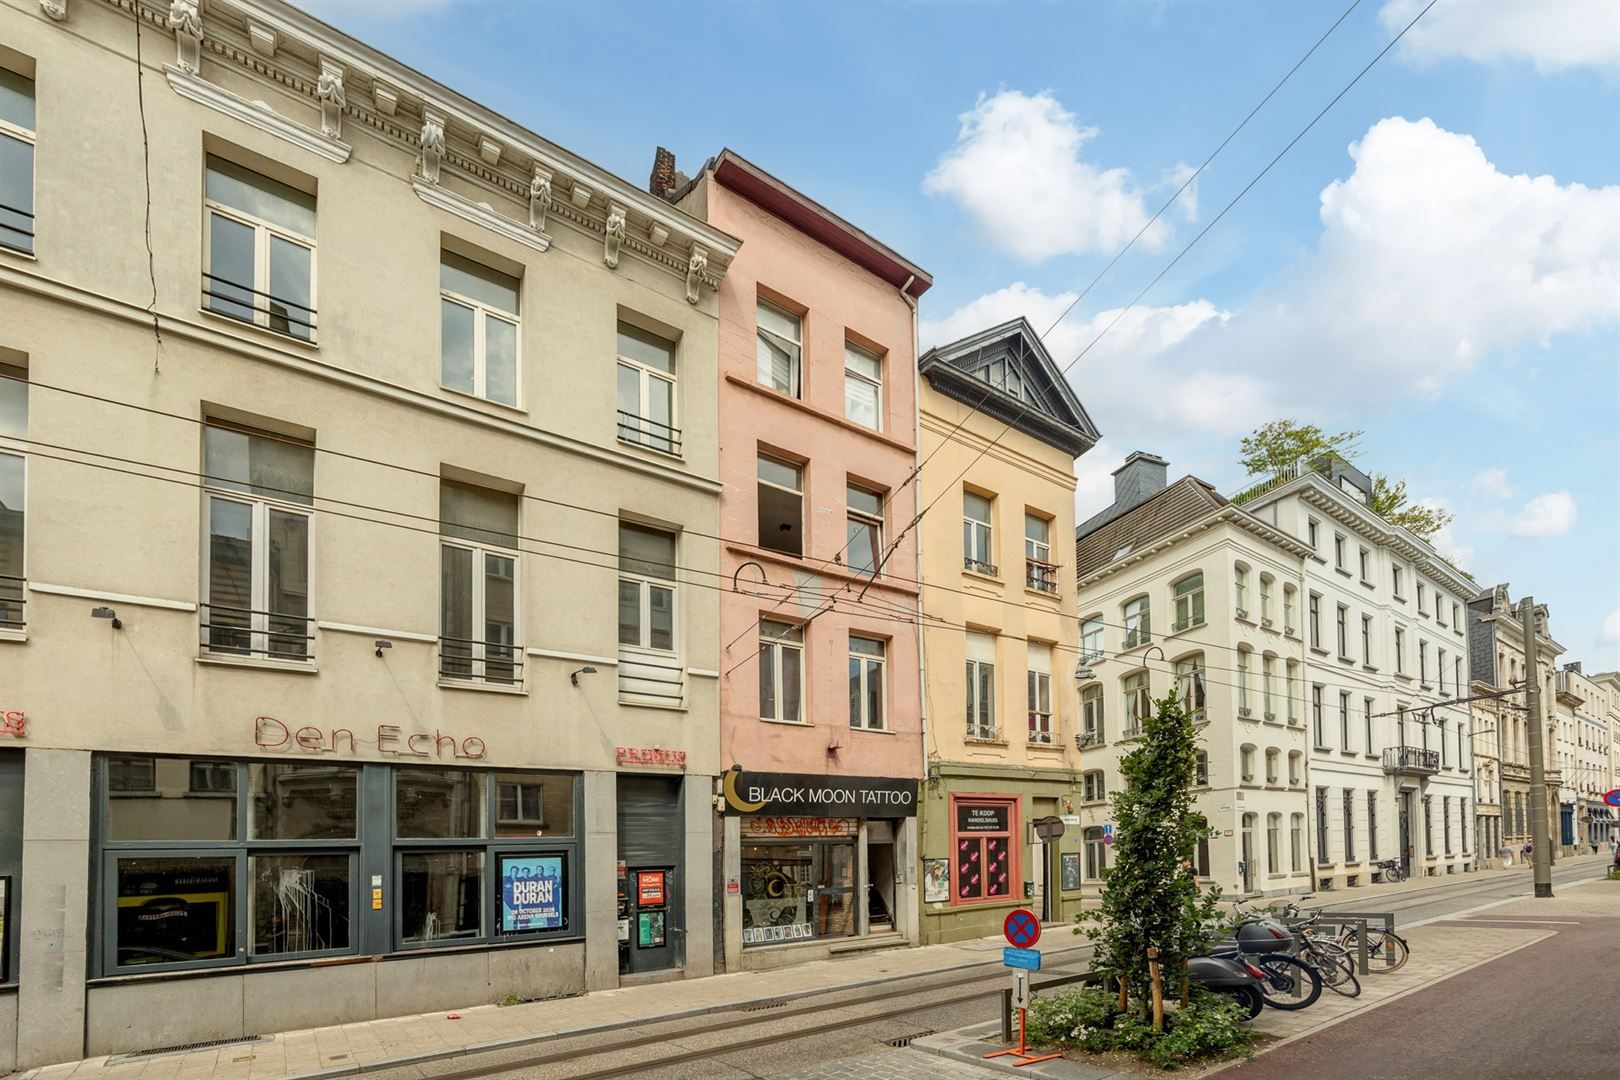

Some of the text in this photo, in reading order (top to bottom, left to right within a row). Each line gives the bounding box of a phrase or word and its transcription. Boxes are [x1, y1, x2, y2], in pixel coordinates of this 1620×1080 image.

[255, 716, 486, 758] Den Echo
[616, 747, 686, 765] PRIMUS
[749, 786, 912, 805] BLACK MOON TATTOO
[513, 880, 553, 893] DURAN
[513, 891, 553, 905] DURAN
